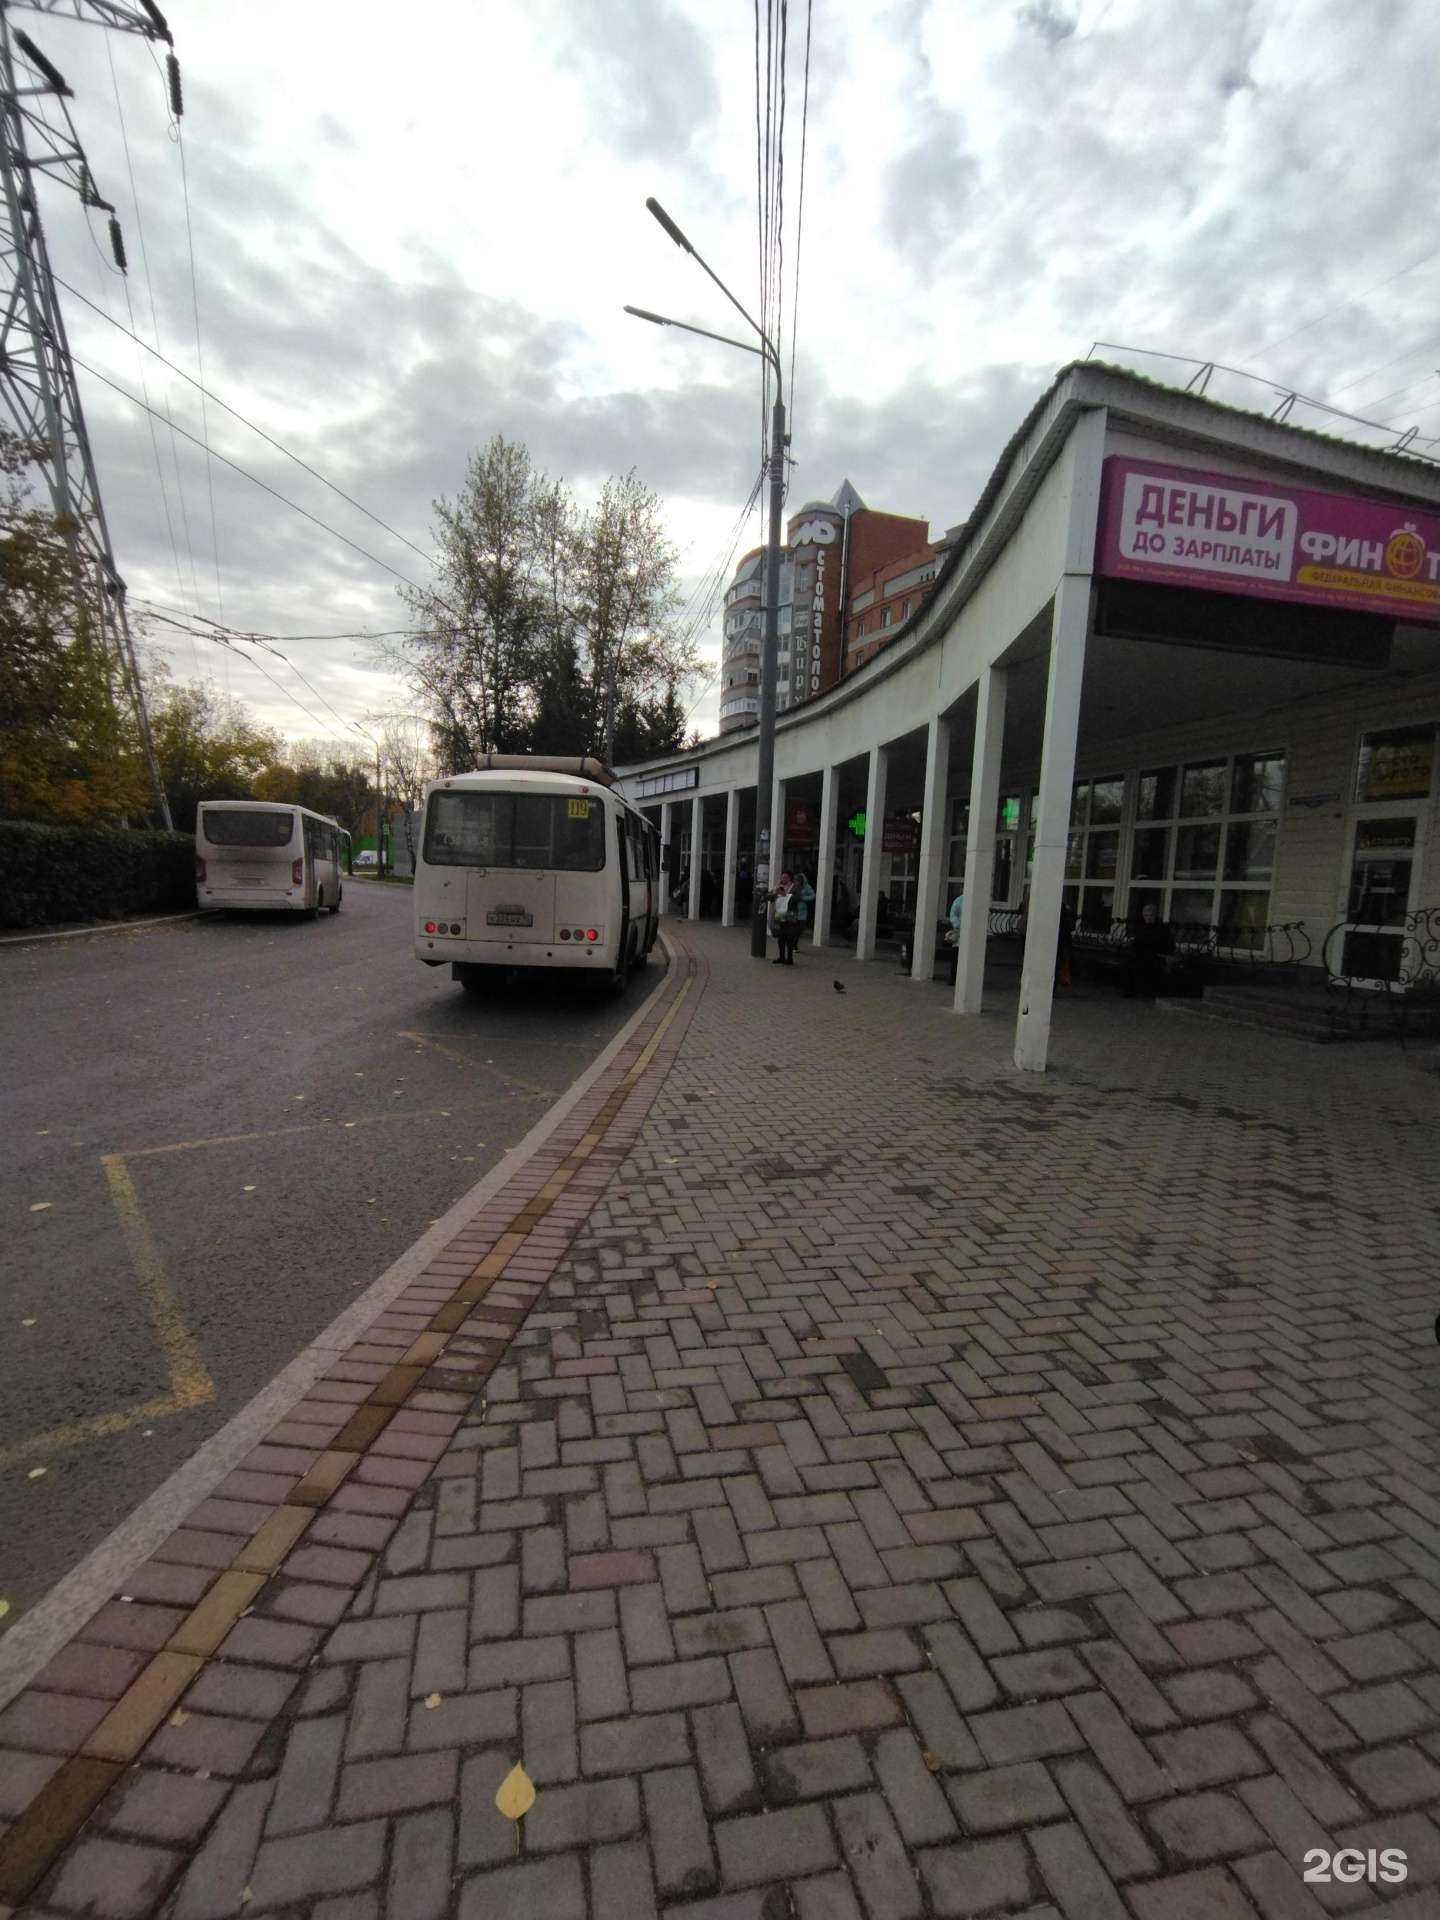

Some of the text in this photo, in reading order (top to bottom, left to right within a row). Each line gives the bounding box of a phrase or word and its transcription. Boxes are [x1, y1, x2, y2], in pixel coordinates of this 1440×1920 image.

[1135, 484, 1286, 541] ДЕНЬГИ
[1132, 531, 1281, 570] ДО ЗАРПЛАТЫ
